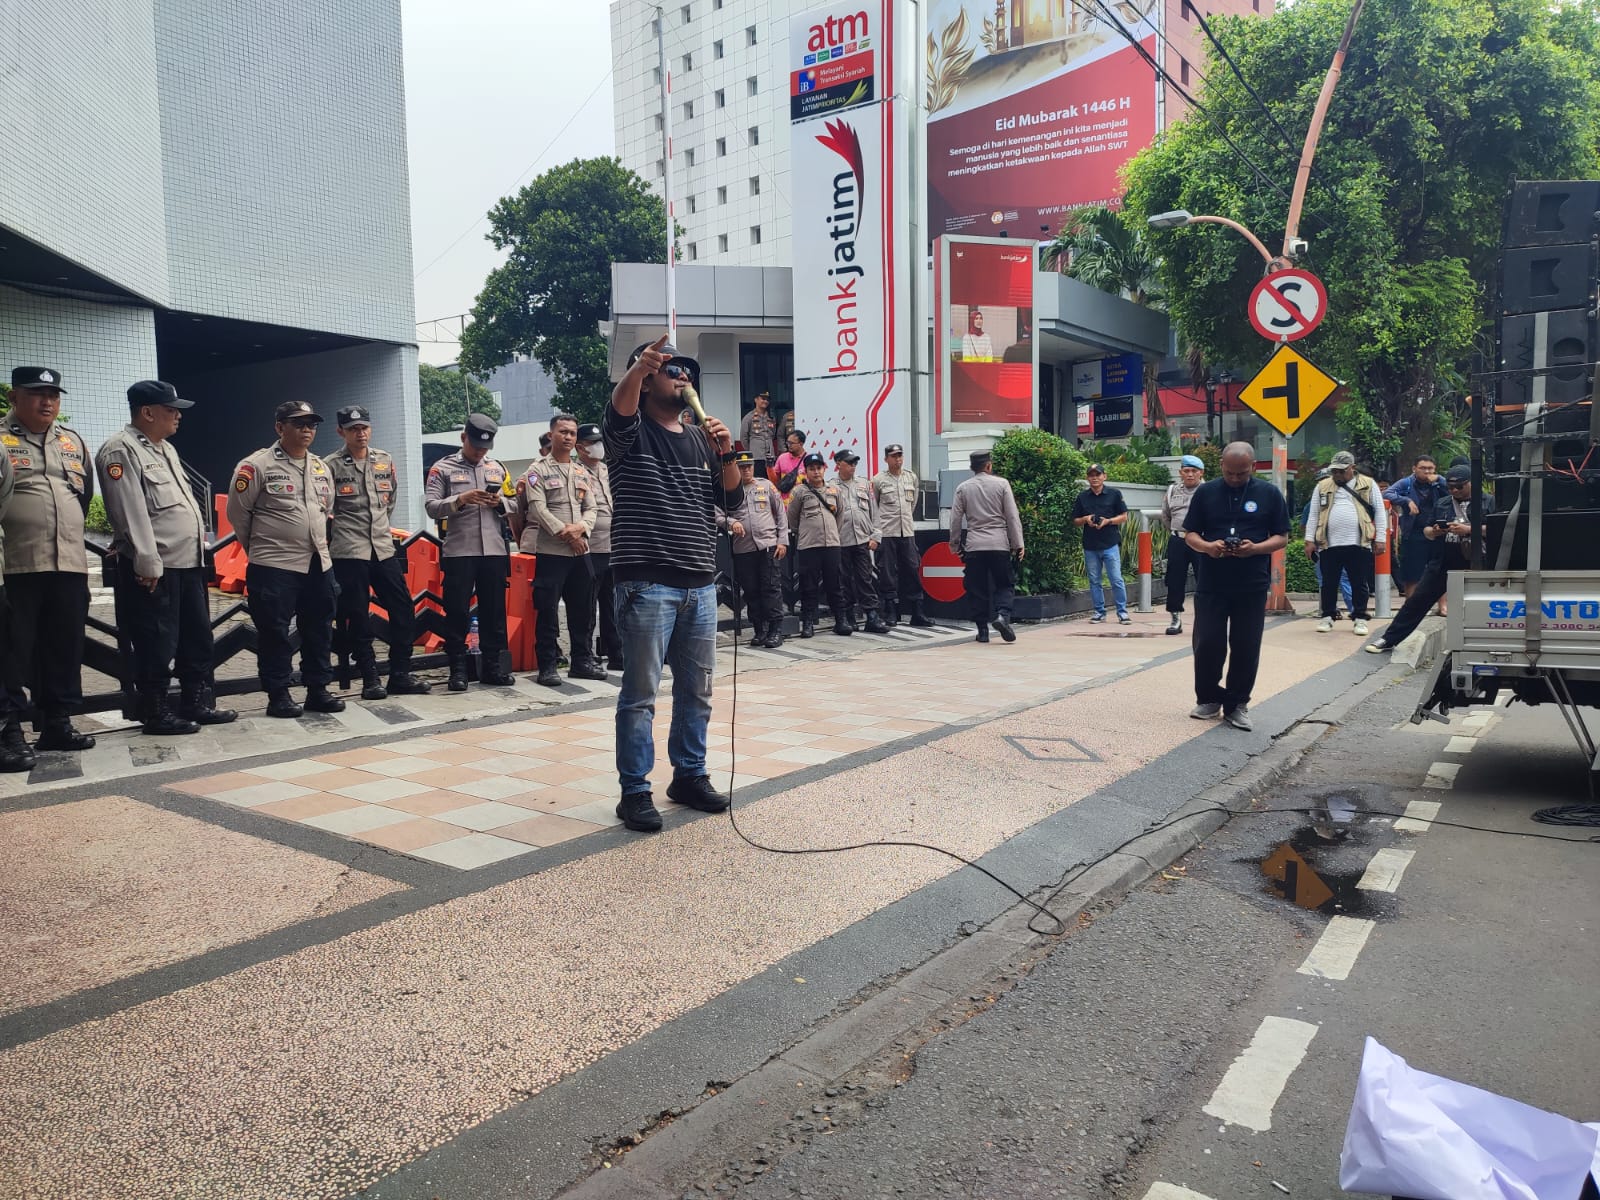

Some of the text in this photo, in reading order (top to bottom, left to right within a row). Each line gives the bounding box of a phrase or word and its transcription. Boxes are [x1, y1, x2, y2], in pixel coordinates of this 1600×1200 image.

[807, 11, 868, 51] atm
[820, 64, 844, 75] Melayani
[845, 67, 865, 78] Syariah
[801, 93, 828, 105] LAYANAN
[995, 96, 1130, 131] Eid Mubarak 1446 H
[949, 118, 1128, 156] Semoga di hari kemenangan ini kita menjadi
[966, 130, 1128, 163] manusia yang lebih baik dan senantiasa
[948, 140, 1128, 176] meningkatkan ketakwaan kepada Allah SWT
[826, 171, 864, 372] bankjatim
[1096, 413, 1119, 422] ASABRI
